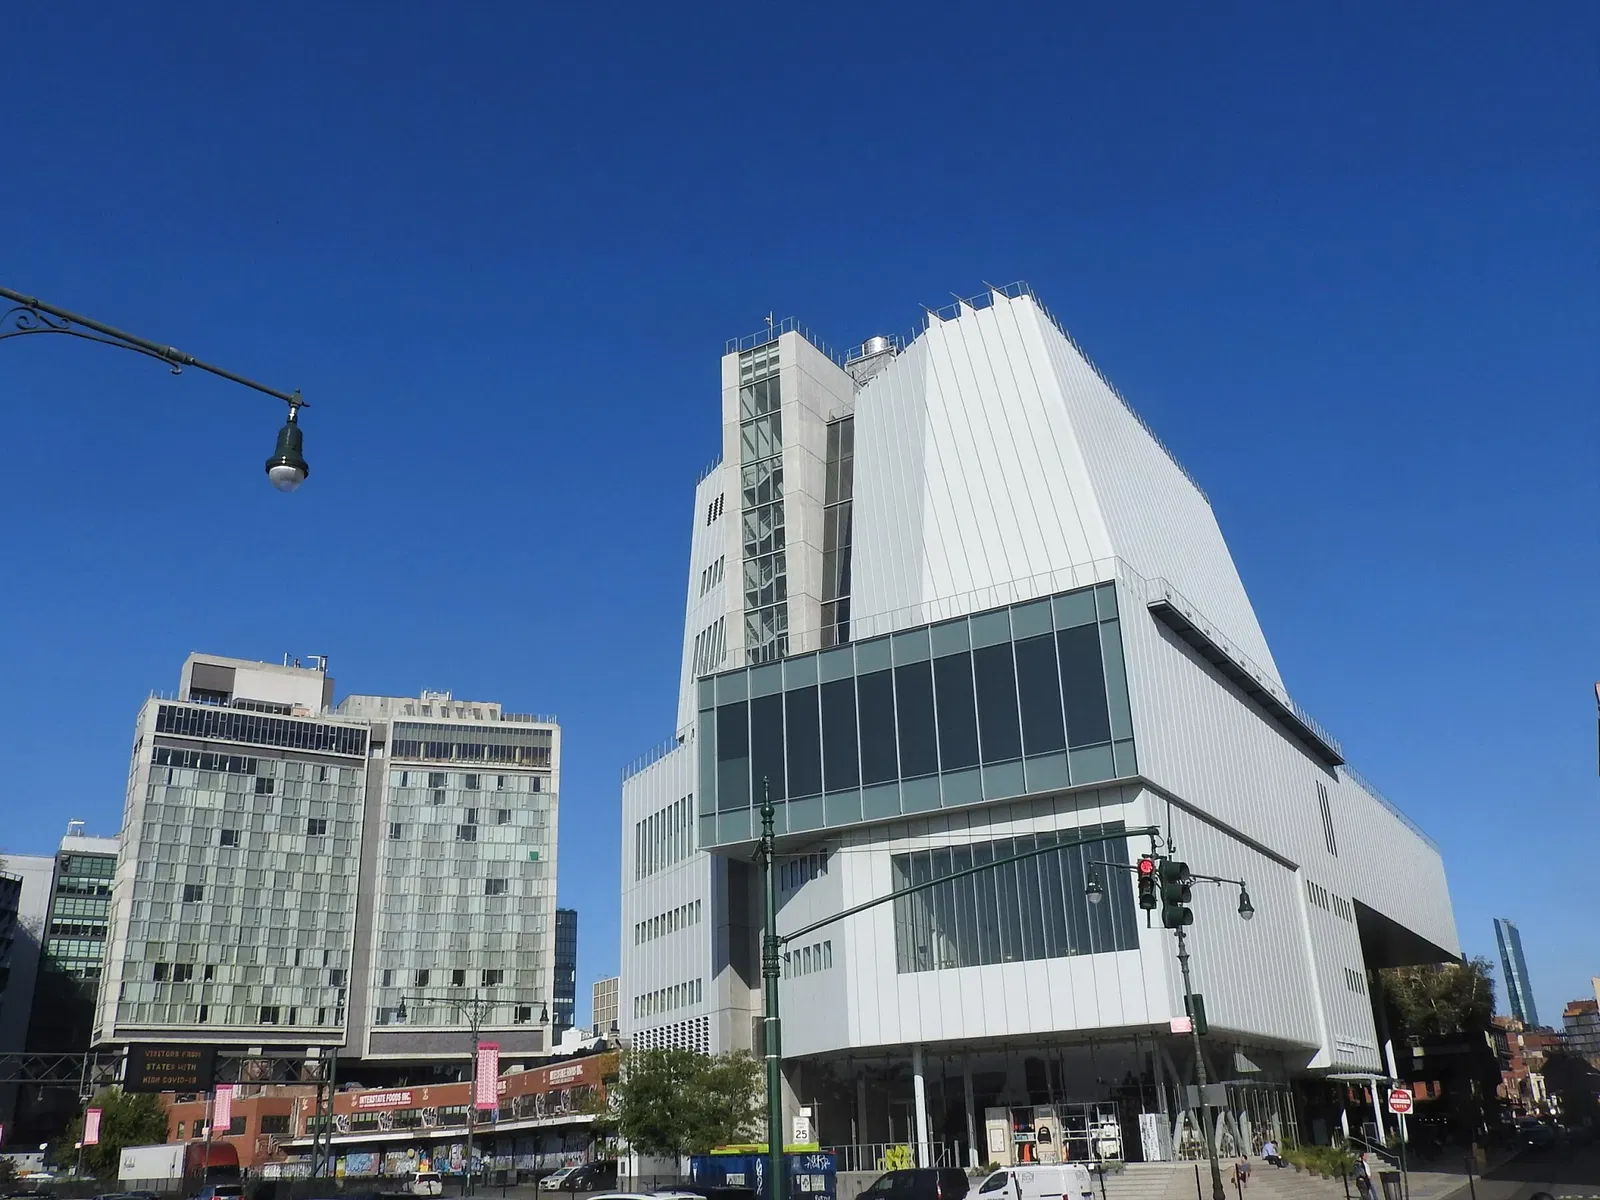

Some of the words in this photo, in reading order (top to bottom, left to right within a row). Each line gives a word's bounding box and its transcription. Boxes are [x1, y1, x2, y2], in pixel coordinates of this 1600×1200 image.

[145, 1050, 180, 1058] VISITORS
[146, 1063, 175, 1071] STATES
[177, 1063, 197, 1071] WITH
[162, 1076, 197, 1084] COVID-19
[359, 1093, 386, 1105] INTERSTATE
[386, 1092, 401, 1102] FOODS
[795, 1129, 808, 1139] 25
